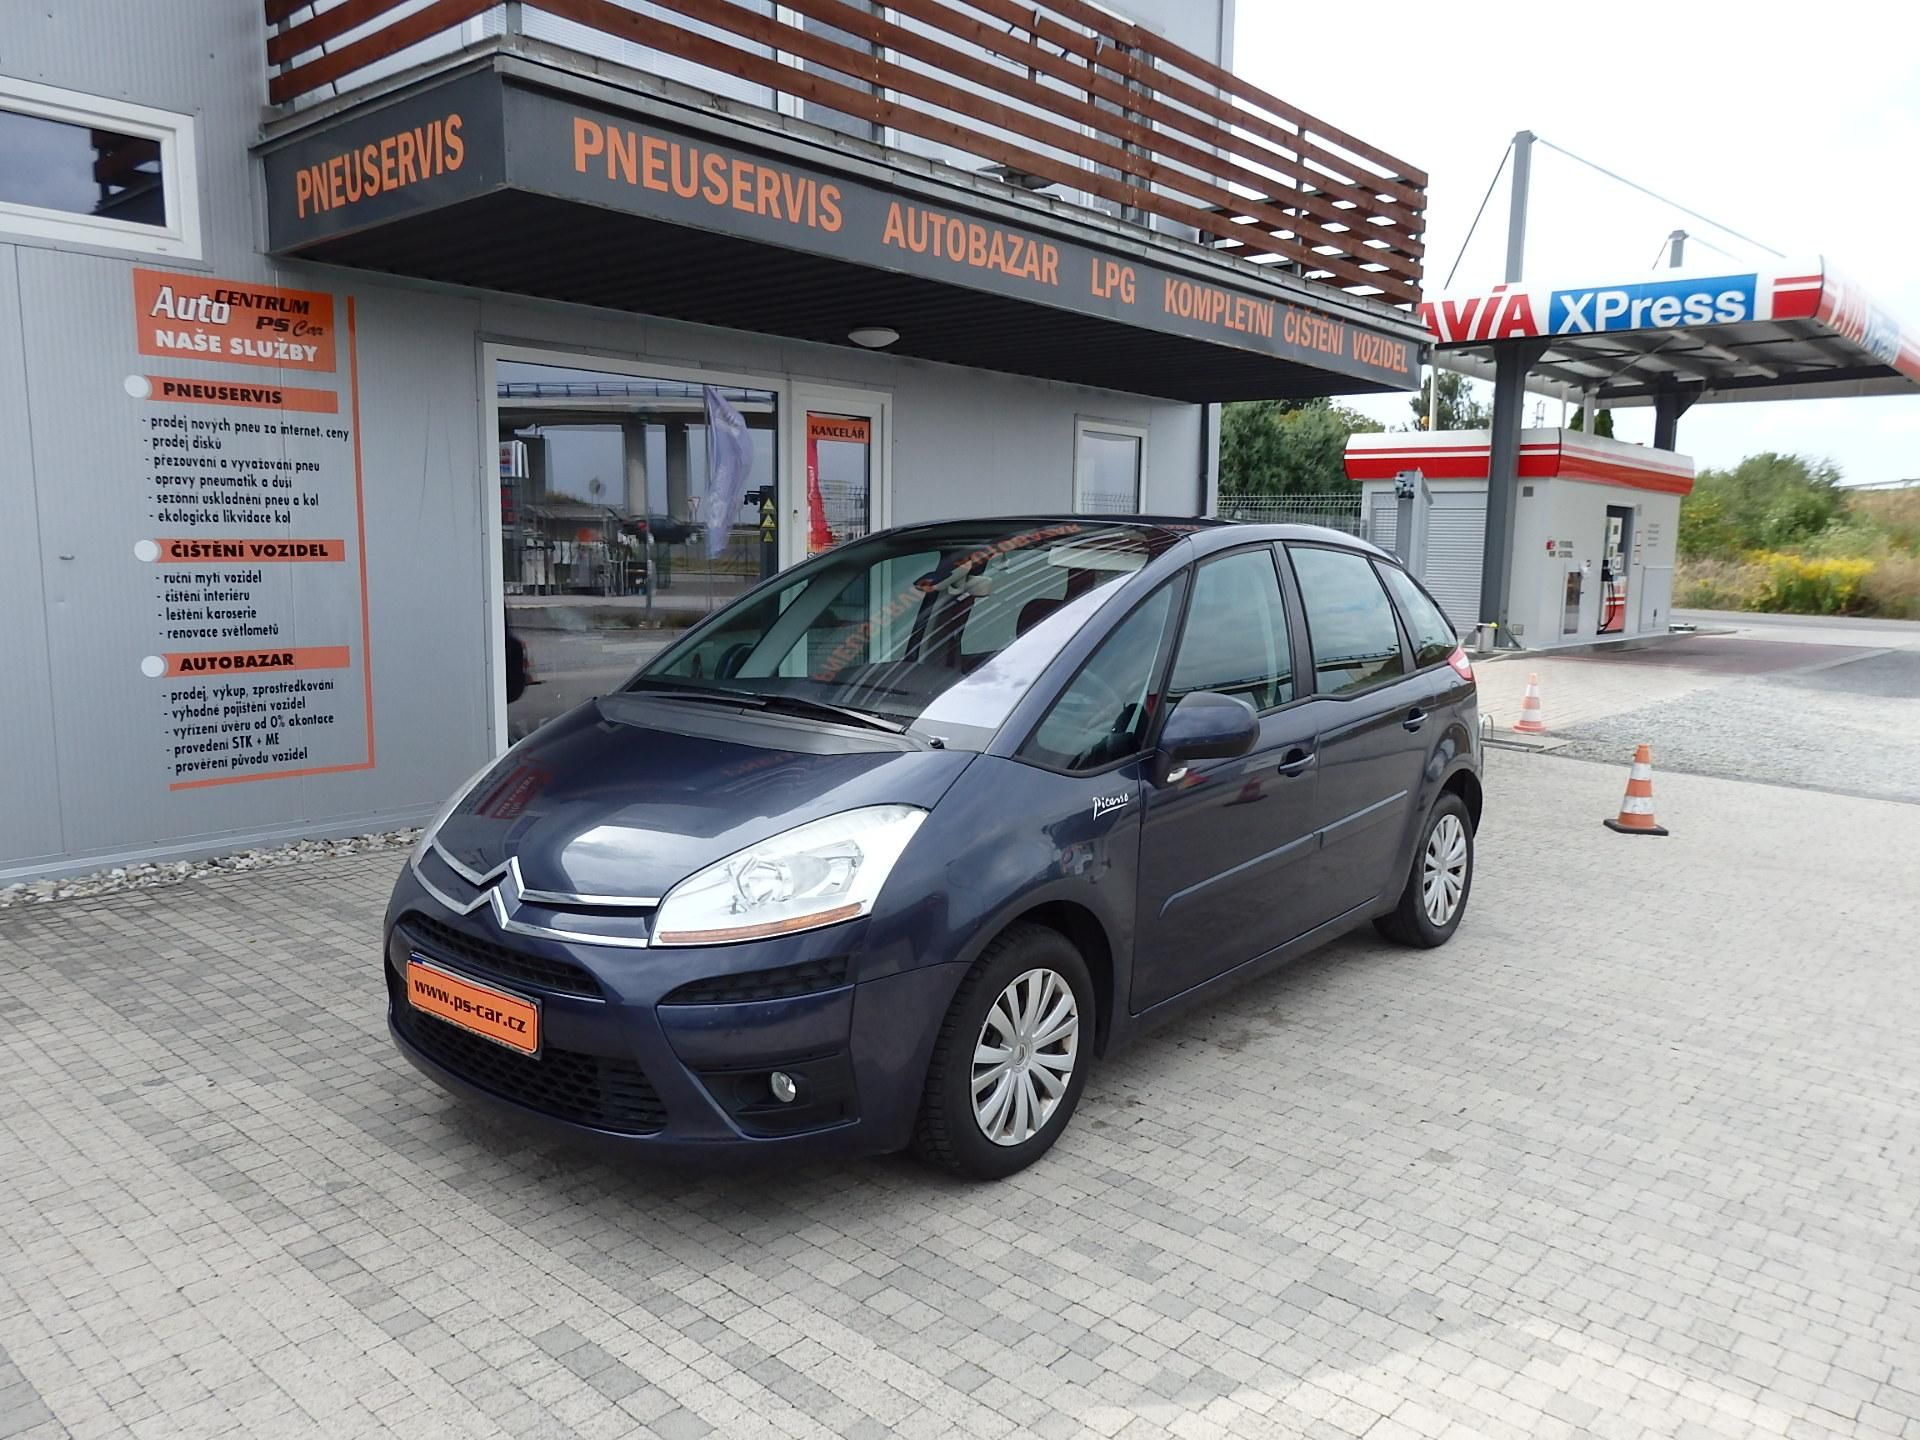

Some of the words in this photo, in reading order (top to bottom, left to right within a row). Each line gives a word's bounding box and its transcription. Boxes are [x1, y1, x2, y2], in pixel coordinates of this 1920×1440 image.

[296, 113, 465, 218] PNEUSERVIS
[573, 116, 844, 233] PNEUSERVIS
[882, 201, 1059, 286] AUTOBAZAR
[1091, 257, 1136, 305] LPG
[1164, 279, 1275, 338] KOMPLETNÍ
[1283, 302, 1344, 356] ČIŠTĚNÍ
[1352, 331, 1408, 373] VOZIDEL
[150, 284, 232, 326] Auto
[214, 289, 310, 315] CENTRUM
[1559, 288, 1748, 334] XPress
[255, 316, 291, 333] PS
[292, 320, 325, 337] Car
[155, 328, 222, 353] NAŠE
[229, 337, 318, 362] SLUŽBY
[163, 382, 282, 404] PNEUSERVIS
[151, 414, 188, 433] prodej
[191, 417, 231, 434] nových
[234, 422, 261, 436] pneu
[264, 424, 277, 434] za
[326, 429, 350, 442] ceny
[811, 425, 865, 439] KANCELÁŘ
[152, 434, 189, 452] prodej
[220, 459, 227, 468] a
[295, 461, 321, 474] pneu
[155, 475, 195, 489] opravy
[199, 474, 258, 489] pneumatik
[261, 479, 269, 488] a
[264, 495, 290, 509] pneu
[293, 496, 300, 506] a
[302, 492, 319, 507] kol
[223, 509, 272, 524] likvidace
[274, 510, 291, 524] kol
[170, 540, 245, 558] ČIŠTĚNÍ
[249, 544, 328, 557] VOZIDEL
[224, 570, 263, 584] vozidel
[206, 605, 257, 620] karoserie
[167, 628, 218, 639] renovace
[222, 622, 279, 637] světlometů
[180, 653, 294, 672] AUTOBAZAR
[270, 696, 306, 711] vozidel
[254, 716, 267, 729] od
[270, 715, 286, 728] 0%
[288, 714, 335, 727] akontace
[232, 735, 253, 749] STK
[265, 732, 280, 746] ME
[271, 746, 308, 762] vozidel
[414, 979, 527, 1034] www.ps-car.cz
